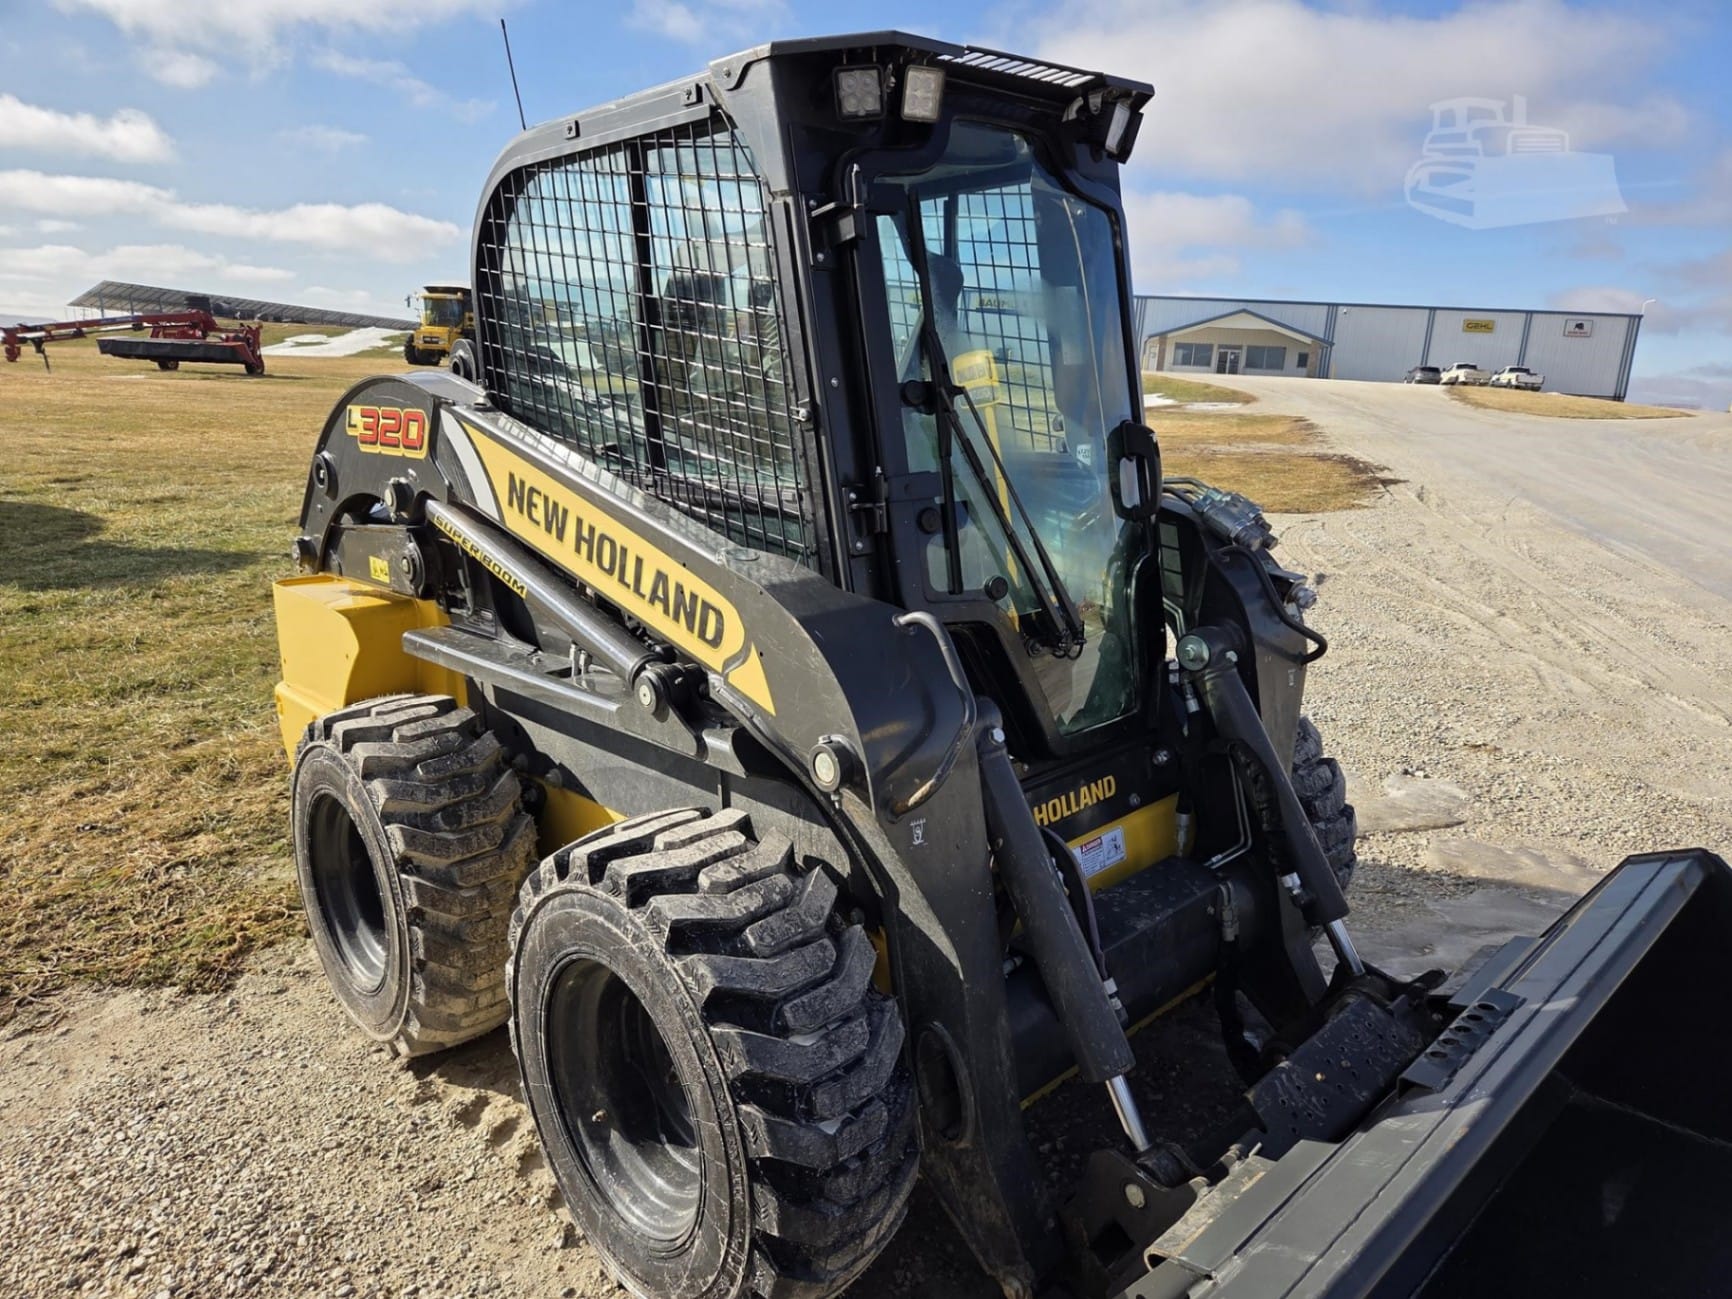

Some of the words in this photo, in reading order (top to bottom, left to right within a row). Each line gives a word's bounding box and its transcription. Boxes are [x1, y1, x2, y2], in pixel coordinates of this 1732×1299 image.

[347, 408, 425, 450] L320
[507, 471, 569, 543] NEW
[574, 515, 725, 649] HOLLAND
[1033, 775, 1117, 826] HOLLAND
